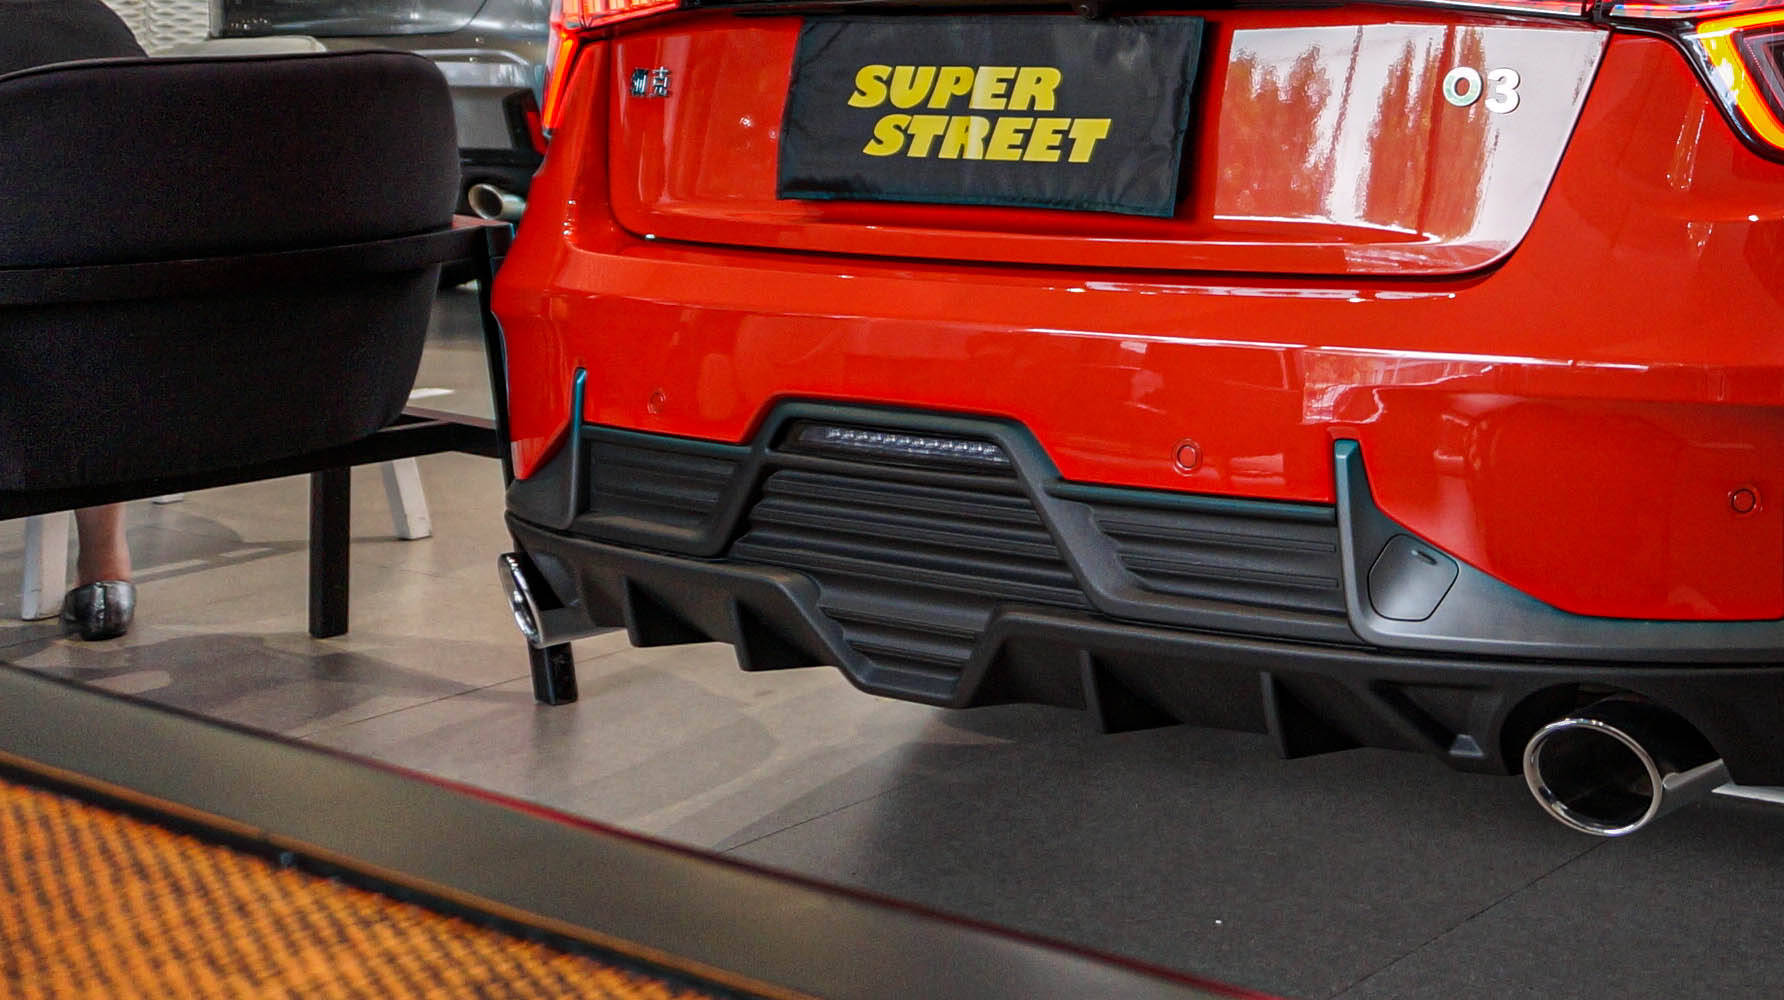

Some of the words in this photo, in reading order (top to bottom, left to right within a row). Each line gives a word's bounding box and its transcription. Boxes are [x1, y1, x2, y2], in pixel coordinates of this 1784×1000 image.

[848, 64, 1061, 111] SUPER
[1442, 66, 1521, 114] 03
[862, 113, 1111, 163] STREET
